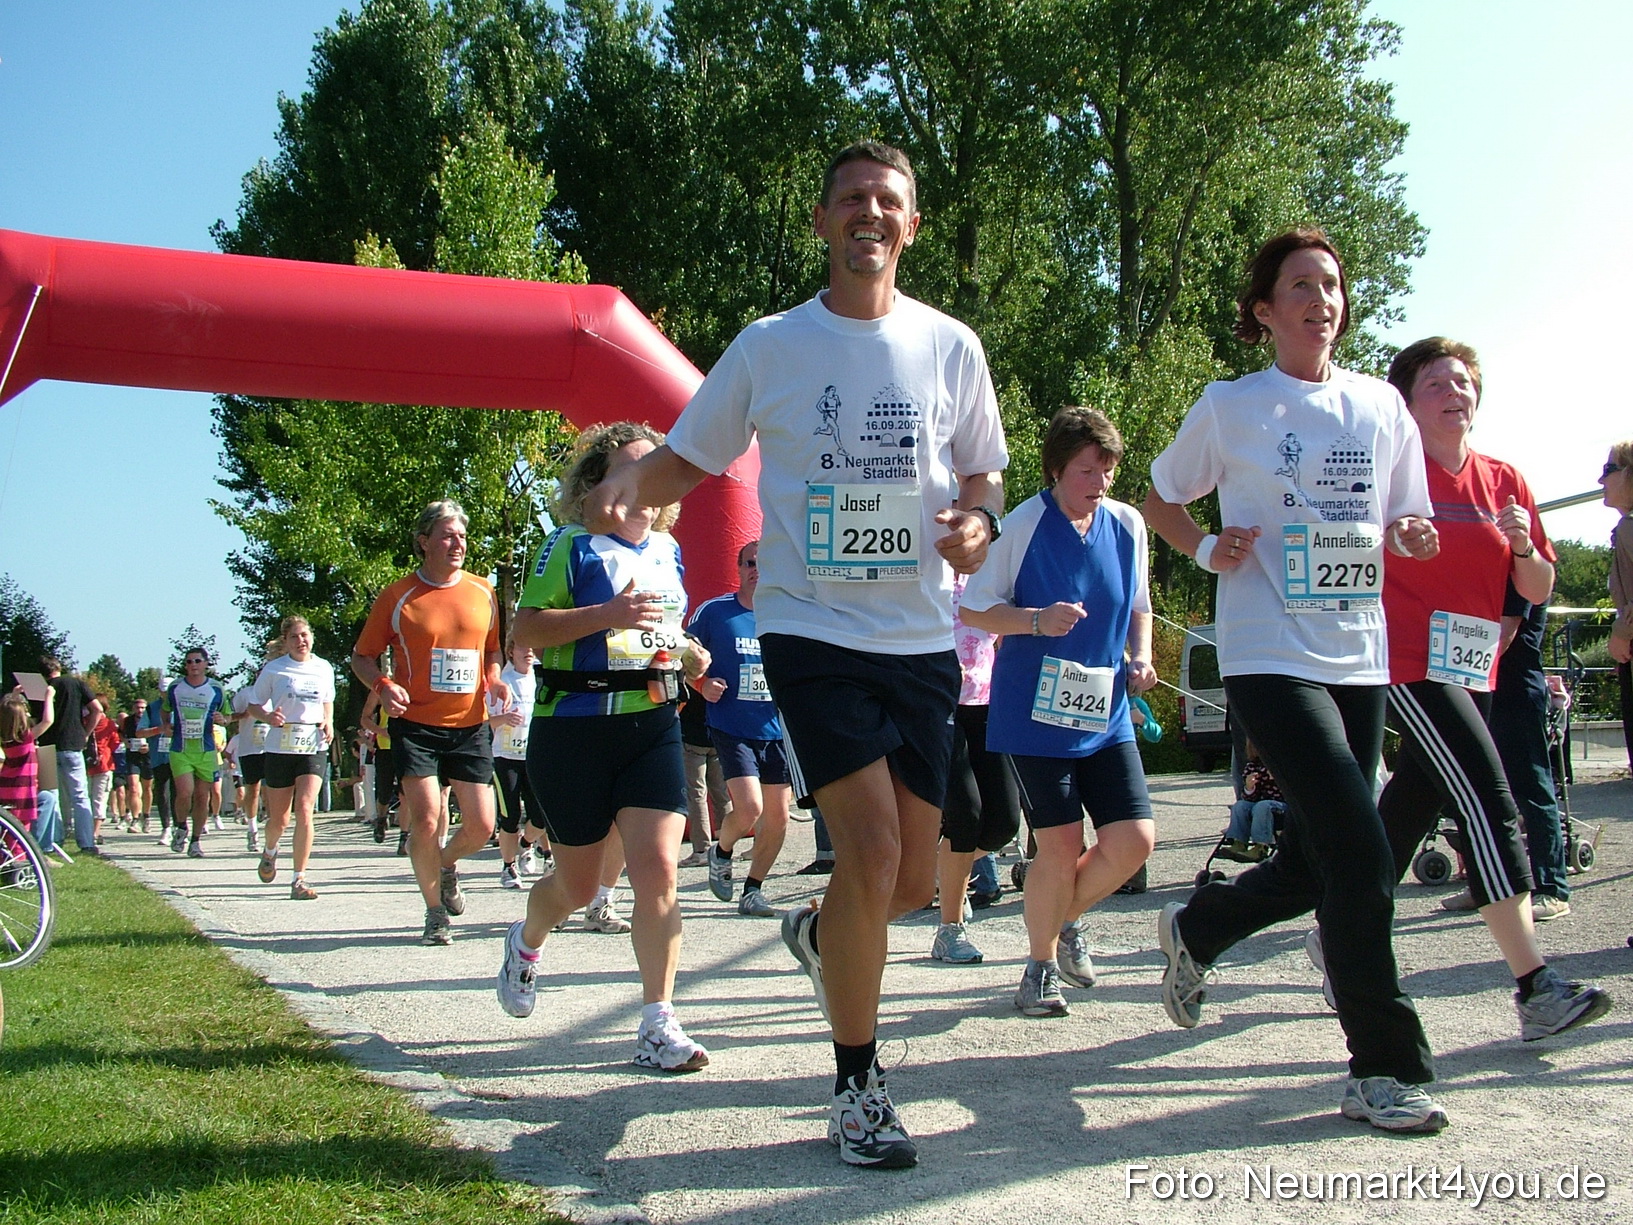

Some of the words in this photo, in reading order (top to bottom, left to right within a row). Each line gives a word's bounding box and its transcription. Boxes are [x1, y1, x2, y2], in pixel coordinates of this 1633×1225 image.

[865, 420, 921, 430] 16.09.2007
[821, 453, 841, 469] 8.
[845, 454, 916, 469] Neumarkte
[863, 466, 917, 479] Stadtlau
[1323, 467, 1373, 476] 16.09.2007
[840, 493, 881, 511] Josef
[1283, 493, 1302, 507] 8.
[1306, 498, 1370, 509] Neumarkter
[1320, 510, 1369, 521] Stadtlauf
[812, 522, 820, 535] D
[842, 528, 911, 554] 2280
[1313, 531, 1373, 548] Anneliese
[879, 566, 918, 575] PFLEIDERER
[1289, 559, 1296, 571] D
[1317, 563, 1377, 587] 2279
[1452, 620, 1489, 639] Angelika
[641, 631, 677, 649] 653
[1452, 646, 1492, 671] 3426
[446, 669, 475, 681] 2150
[1062, 667, 1088, 683] Anita
[753, 680, 769, 691] 30
[1059, 690, 1106, 714] 3424
[295, 737, 312, 746] 786
